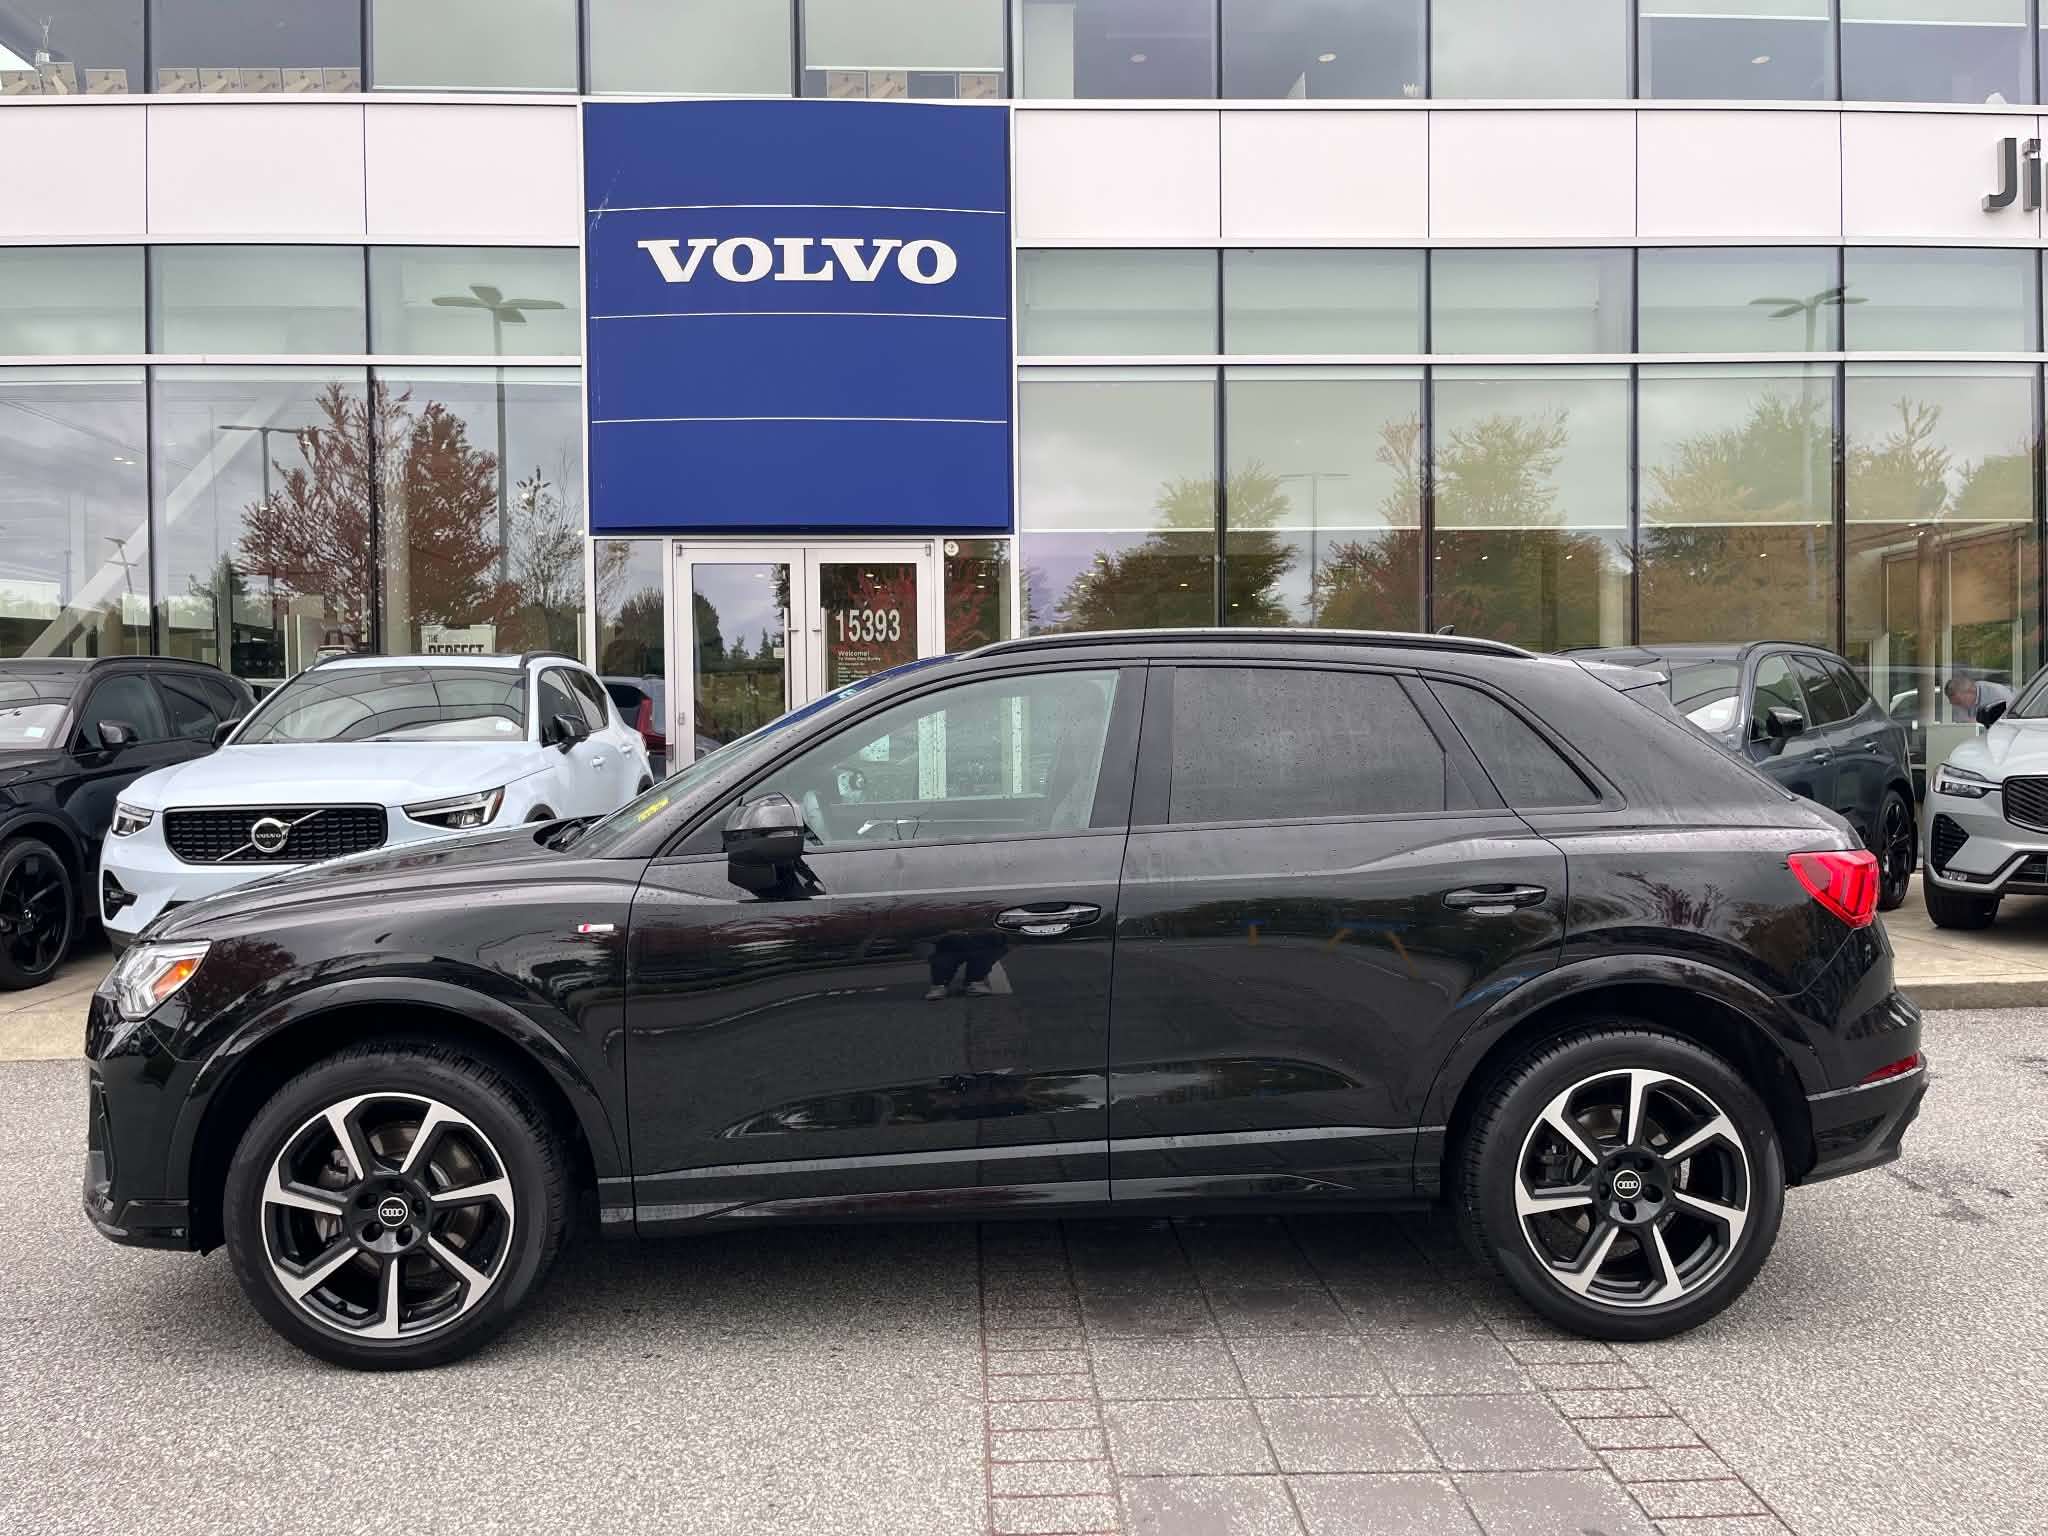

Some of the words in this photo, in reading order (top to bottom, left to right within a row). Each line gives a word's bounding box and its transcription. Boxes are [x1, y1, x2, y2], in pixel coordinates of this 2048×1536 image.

[1982, 137, 2048, 212] Ji
[637, 237, 957, 284] VOLVO
[835, 609, 900, 641] 15393
